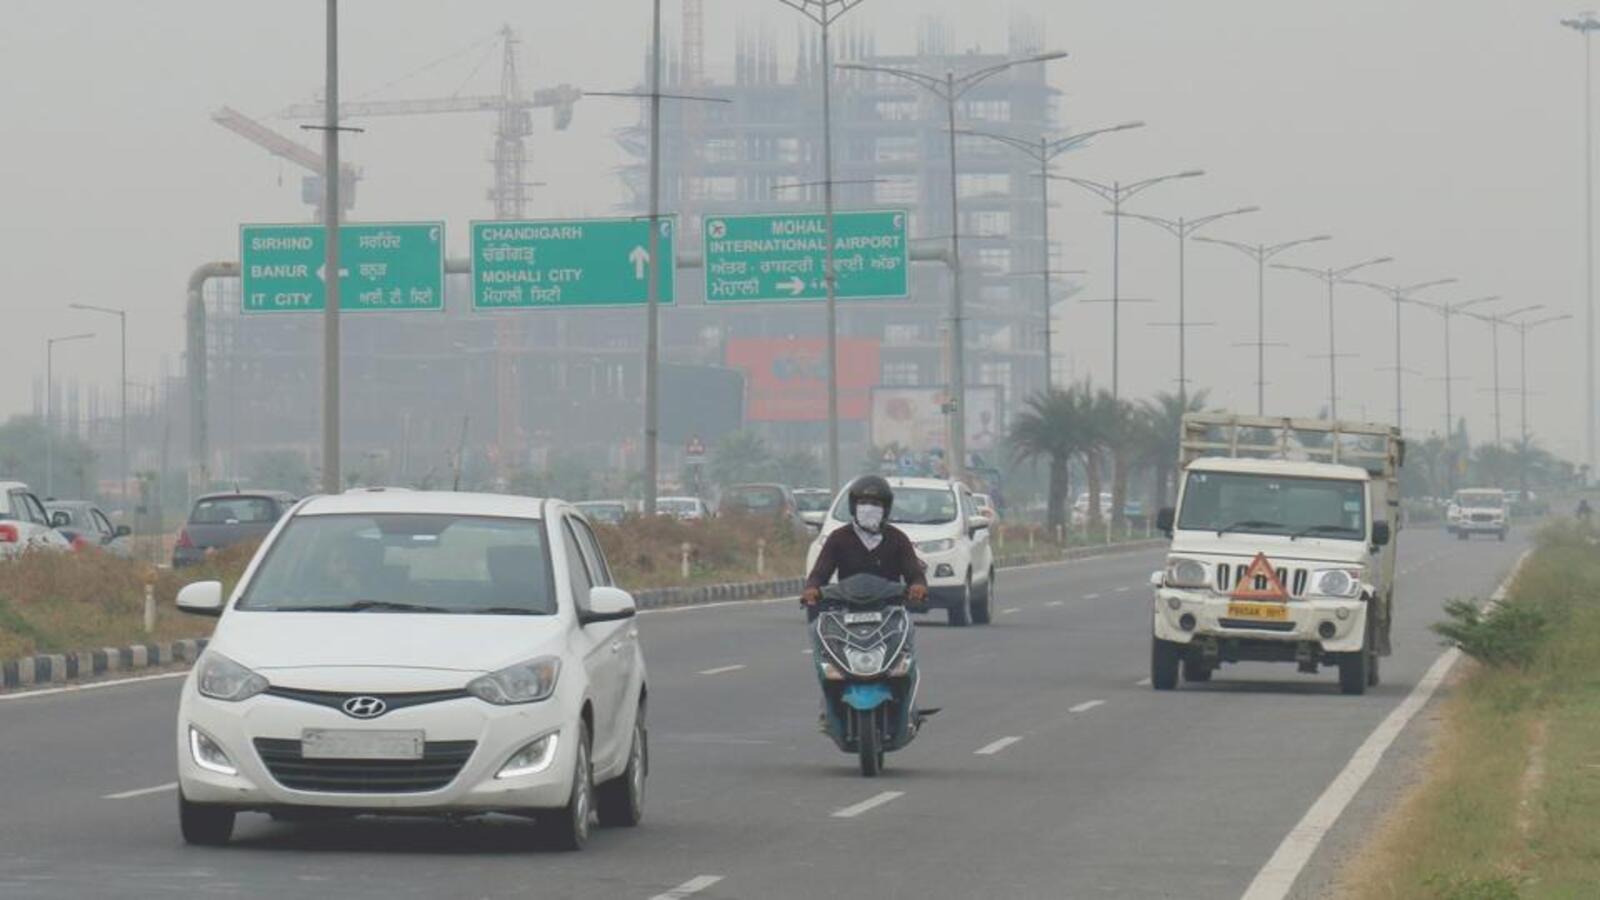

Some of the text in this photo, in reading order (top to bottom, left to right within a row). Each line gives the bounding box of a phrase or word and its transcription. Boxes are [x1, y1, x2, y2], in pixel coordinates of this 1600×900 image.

[772, 219, 827, 235] MOHAL
[482, 227, 583, 241] CHANDIGARH
[251, 237, 313, 250] SIRHIND
[711, 235, 899, 252] INTERNATIONAL AIRPORT
[251, 265, 308, 278] BANUR
[483, 269, 583, 282] MOHALI CITY
[252, 293, 312, 305] IT CITY
